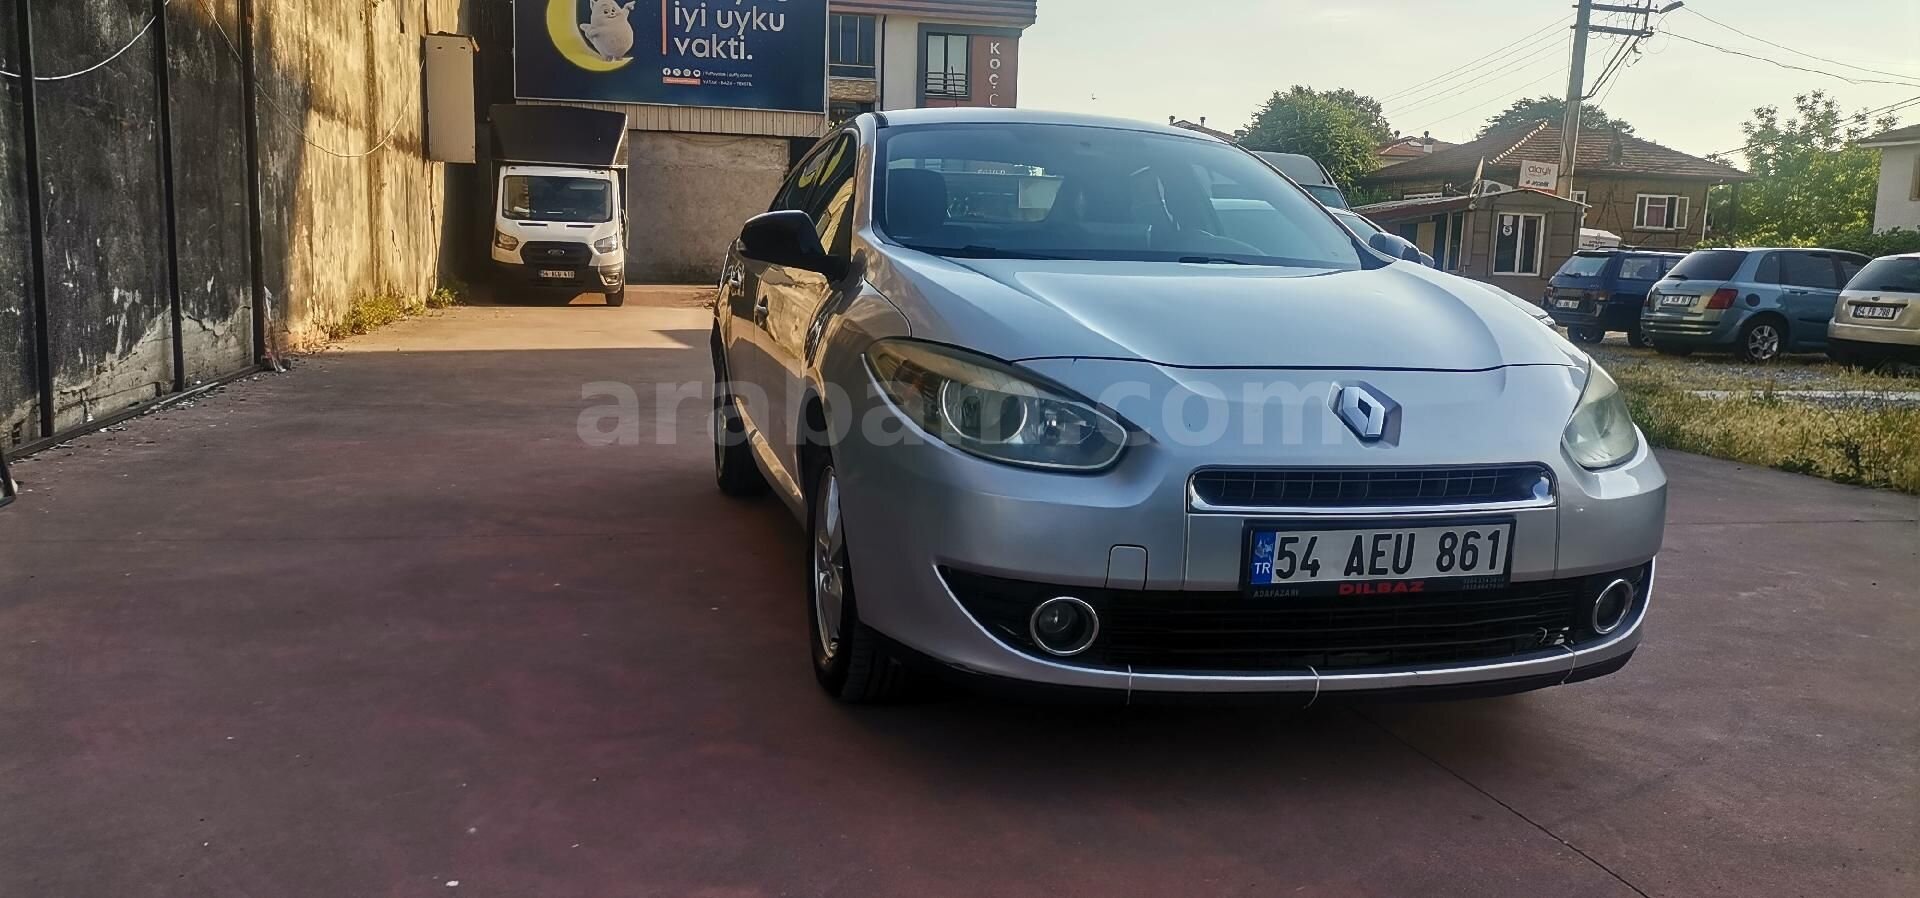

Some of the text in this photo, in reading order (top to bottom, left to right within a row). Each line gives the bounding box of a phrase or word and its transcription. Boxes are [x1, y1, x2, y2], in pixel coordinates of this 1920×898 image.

[674, 0, 785, 35] iyi uyku
[673, 33, 753, 60] vakti.
[1275, 529, 1501, 579] 54 AEU 861
[1254, 562, 1271, 575] TR
[1338, 580, 1425, 596] DILBAZ
